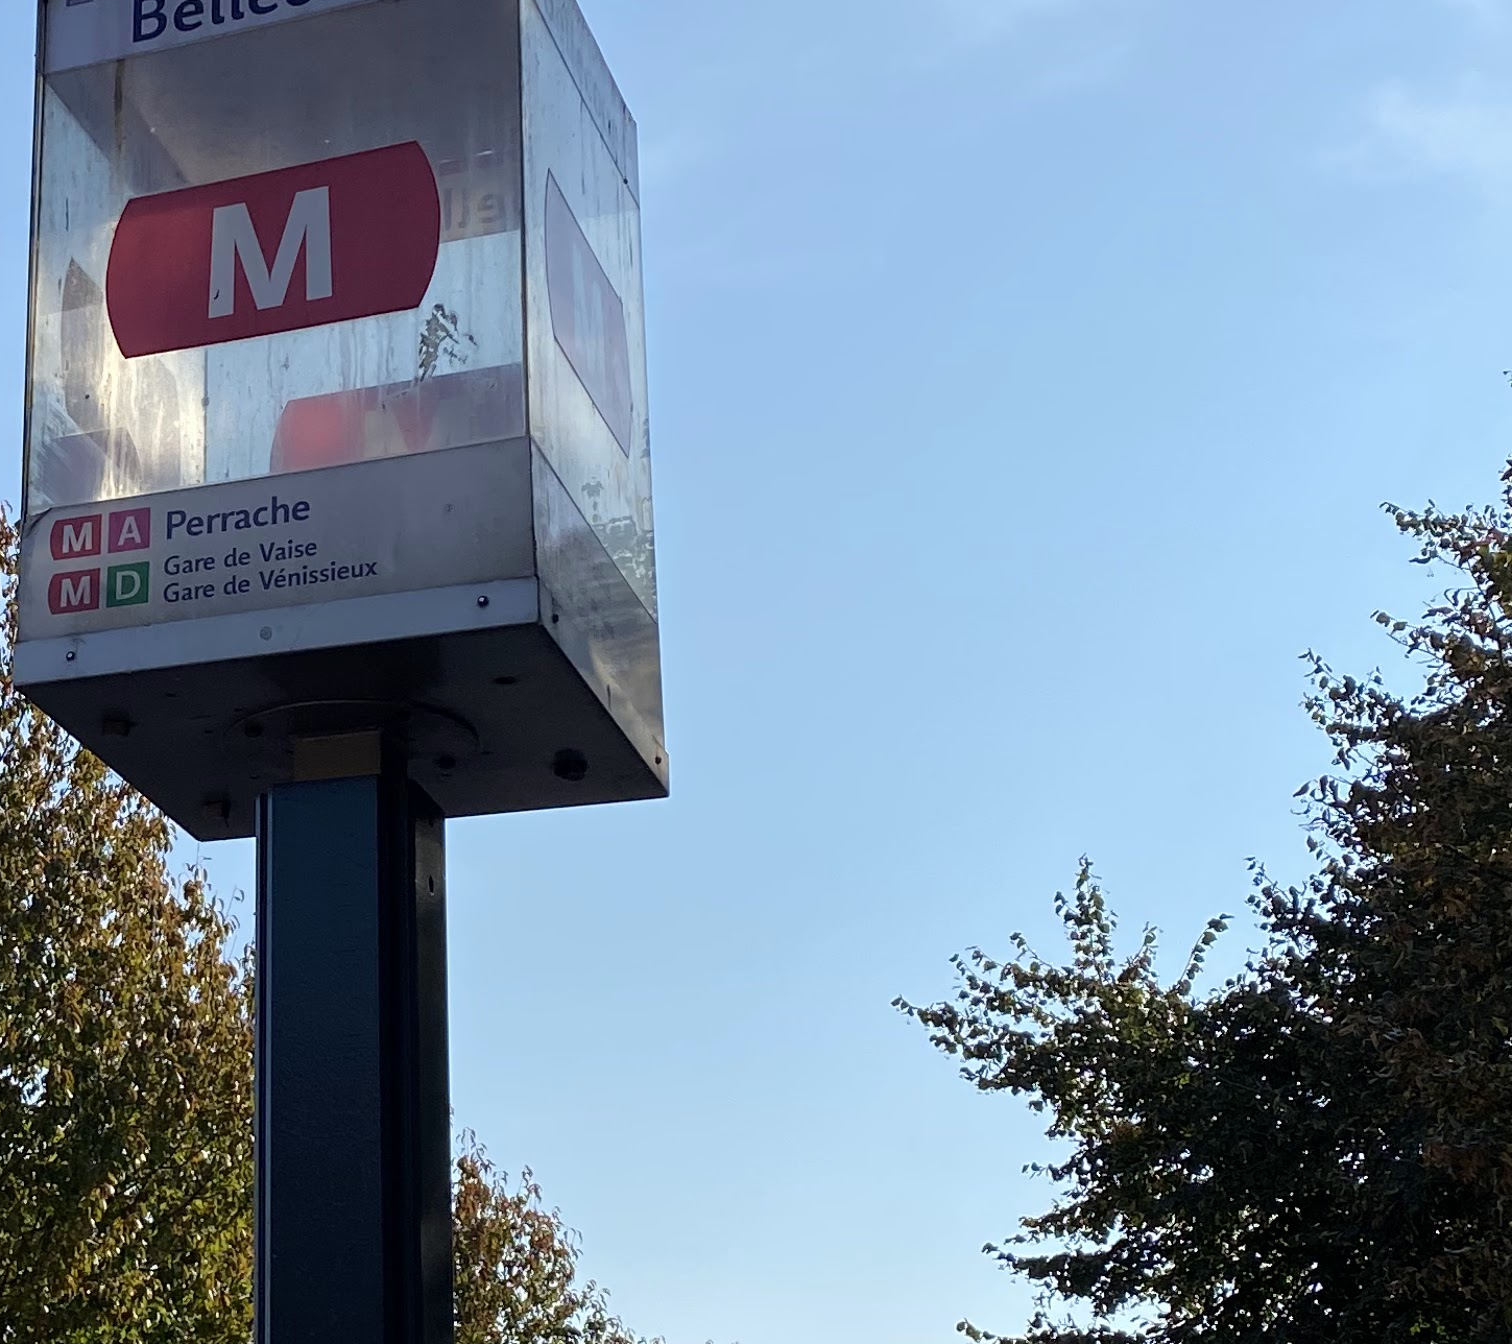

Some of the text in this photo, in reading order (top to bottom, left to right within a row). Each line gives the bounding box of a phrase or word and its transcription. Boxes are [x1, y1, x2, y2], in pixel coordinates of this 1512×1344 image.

[207, 186, 334, 319] M
[61, 515, 142, 554] M A
[166, 495, 312, 541] Perrache
[163, 539, 318, 576] Gare de Vaise
[59, 569, 142, 608] M D
[163, 560, 379, 603] Gare de Vénissieux
